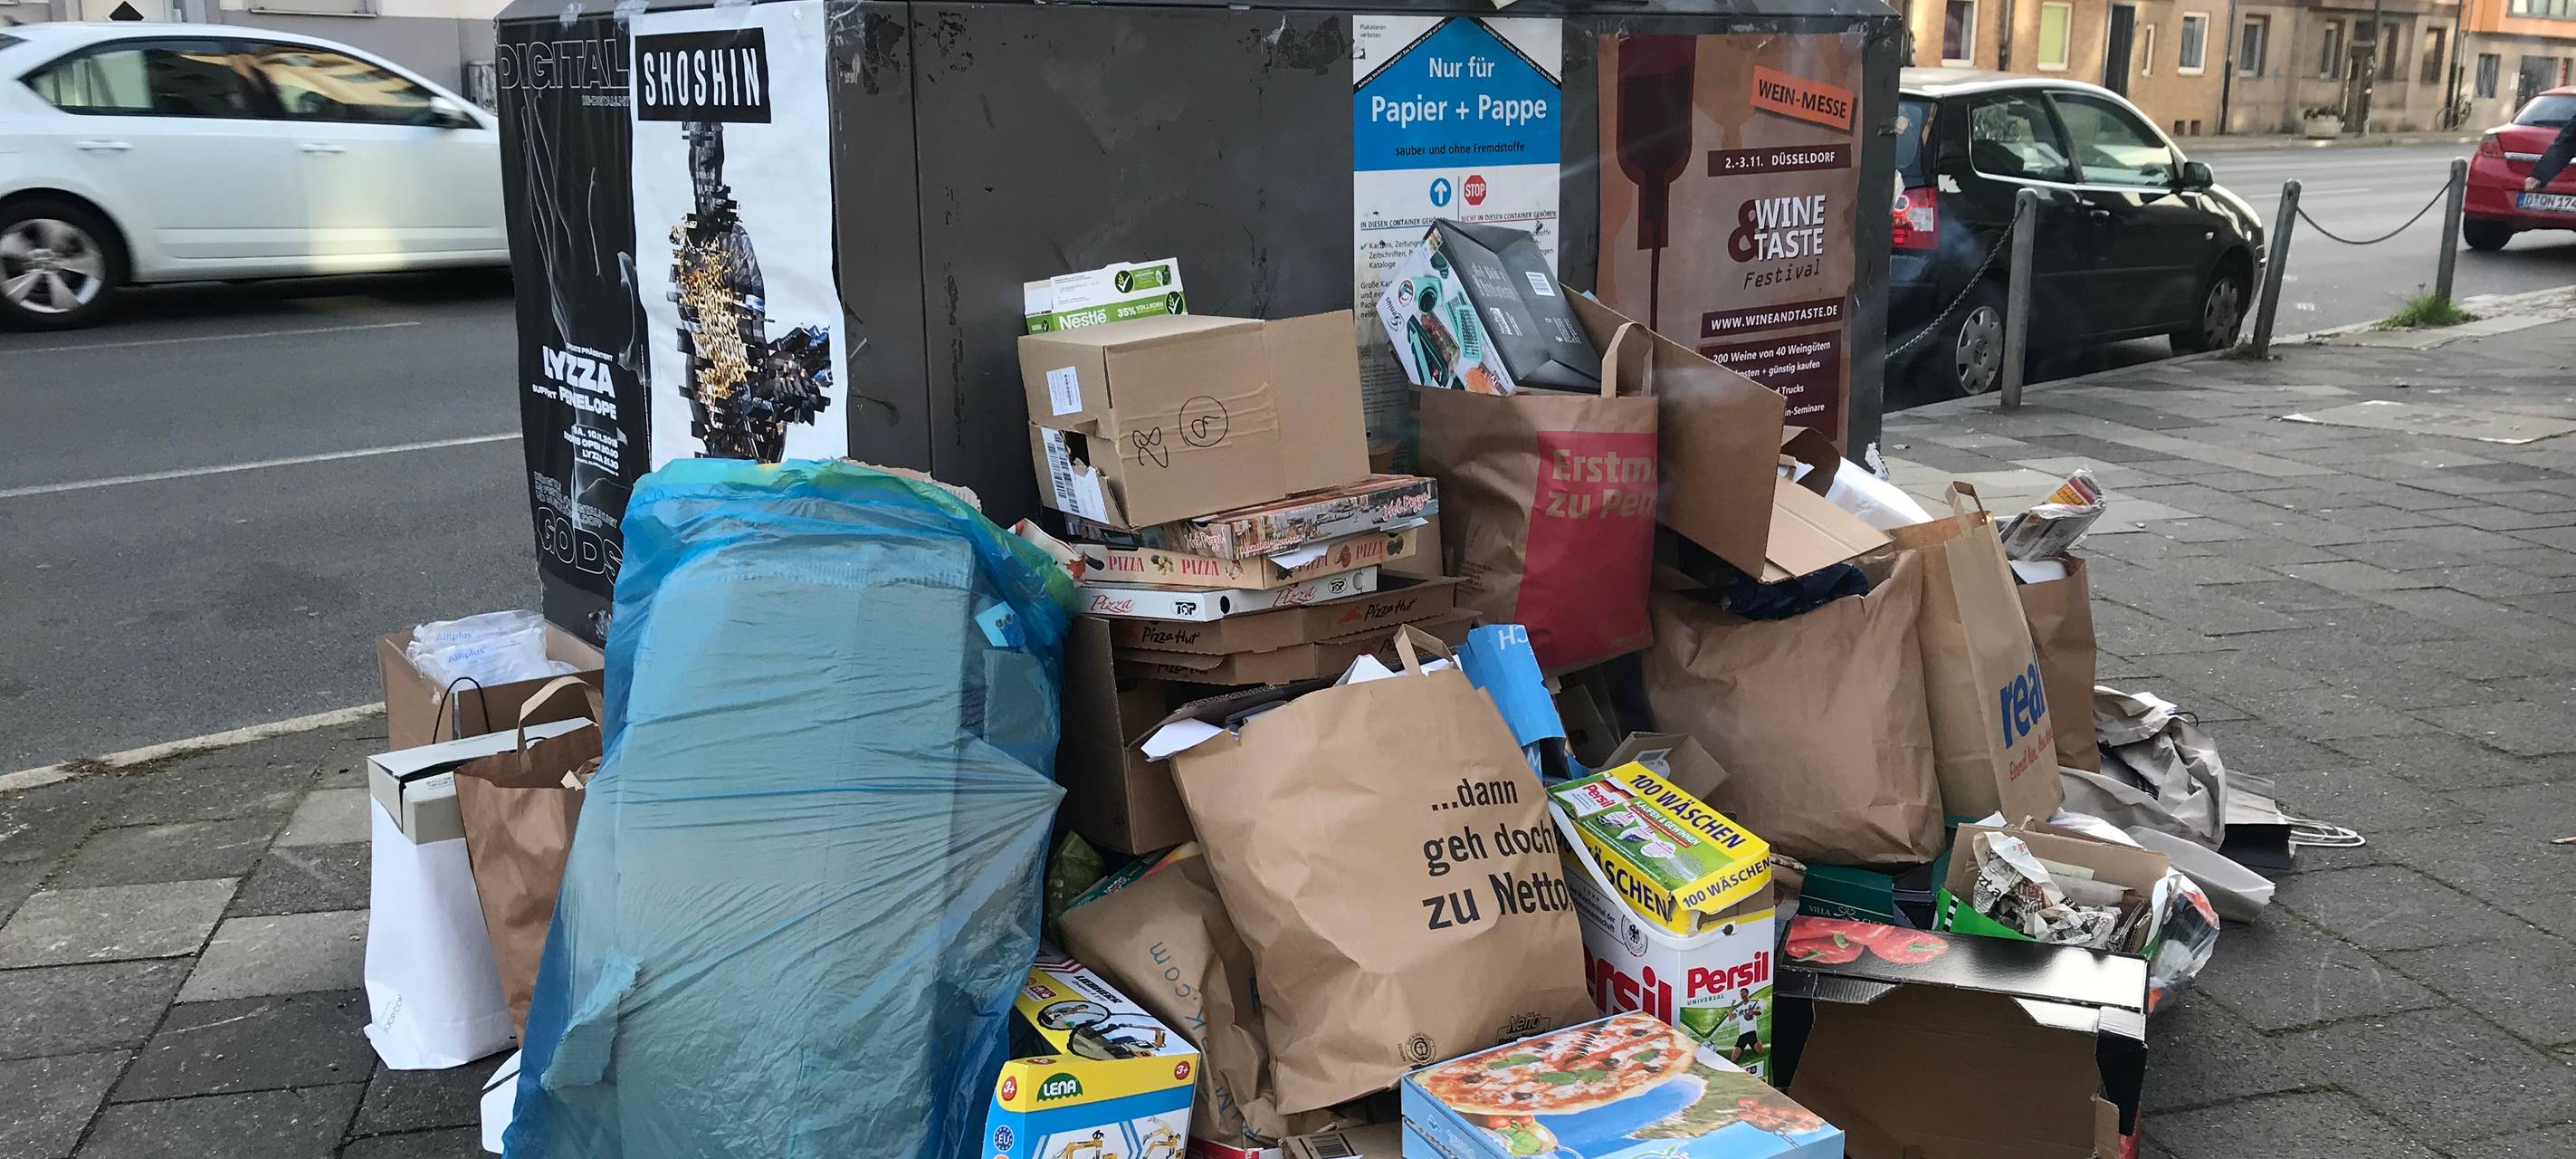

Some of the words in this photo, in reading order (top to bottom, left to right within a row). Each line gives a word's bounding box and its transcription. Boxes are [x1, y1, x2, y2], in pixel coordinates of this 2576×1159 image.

[498, 38, 630, 90] DIGITAL
[1429, 57, 1463, 78] Nur
[1467, 55, 1495, 78] für
[644, 48, 760, 106] SHOSHIN
[1759, 79, 1847, 119] WEIN-MESSE
[1371, 94, 1448, 129] Papier
[1455, 101, 1470, 120] +
[1478, 94, 1547, 126] Pappe
[1395, 145, 1426, 157] sauber
[1428, 143, 1446, 155] und
[1448, 142, 1471, 154] ohne
[1473, 140, 1526, 154] Fremdstoffe
[1725, 156, 1764, 169] 2.-3.11.
[1771, 151, 1836, 166] DÜSSELDORF
[1465, 183, 1485, 197] STOP
[1368, 220, 1388, 228] DIESEN
[1389, 217, 1421, 226] CONTAINER
[1484, 213, 1503, 221] DIESEN
[1503, 212, 1532, 220] CONTAINER
[1754, 195, 1827, 229] WINE
[1728, 199, 1762, 263] &
[1754, 228, 1824, 261] TASTE
[1369, 260, 1396, 270] Kataloge
[1743, 258, 1821, 290] Festival
[1360, 281, 1379, 290] Große
[1360, 291, 1372, 299] und
[1117, 306, 1137, 319] 35%
[1710, 304, 1839, 331] WWW.WINEANDTASTE.DE
[1713, 352, 1729, 364] 200
[1730, 350, 1757, 362] Weine
[1759, 350, 1774, 359] von
[1775, 345, 1787, 357] 40
[1787, 341, 1832, 357] Weingütern
[542, 345, 616, 399] LYZZA
[1768, 365, 1796, 378] günstig
[1796, 359, 1821, 371] kaufen
[1781, 384, 1805, 396] Trucks
[558, 385, 617, 421] PENELOPE
[1784, 404, 1826, 417] in-Seminare
[1552, 448, 1658, 484] Erstm
[1545, 491, 1590, 520] zu
[1355, 541, 1384, 560] PIZZA
[1108, 555, 1145, 573] PIZZA
[1181, 559, 1220, 577] PIZZA
[1090, 593, 1136, 614] Pizza
[1272, 586, 1318, 608] Pizza
[1175, 601, 1197, 616] TOP
[1363, 602, 1393, 621] Pizza
[1394, 597, 1419, 614] Hut
[1141, 627, 1174, 644] Pizza
[1174, 629, 1201, 646] Hut
[1430, 778, 1519, 812] ...dann
[1582, 784, 1616, 809] Persil
[1629, 774, 1664, 796] 100
[1655, 790, 1748, 849] WÄSCHEN
[1634, 800, 1661, 820] KAUFEN
[1423, 825, 1489, 877] geh
[1494, 819, 1557, 859] doch
[1586, 846, 1670, 925] ÄSCHEN
[1682, 890, 1706, 909] 100
[1706, 857, 1772, 896] WÄSCHEN
[1422, 887, 1481, 931] zu
[1808, 905, 1832, 917] VILLA
[1583, 943, 1673, 1028] ersil
[1686, 951, 1770, 1000] Persil
[1686, 993, 1725, 1007] UNIVERSAL
[1176, 1063, 1189, 1076] 3+
[1002, 1080, 1016, 1097] 3+
[1043, 1080, 1077, 1097] LENA
[997, 1134, 1010, 1145] EU
